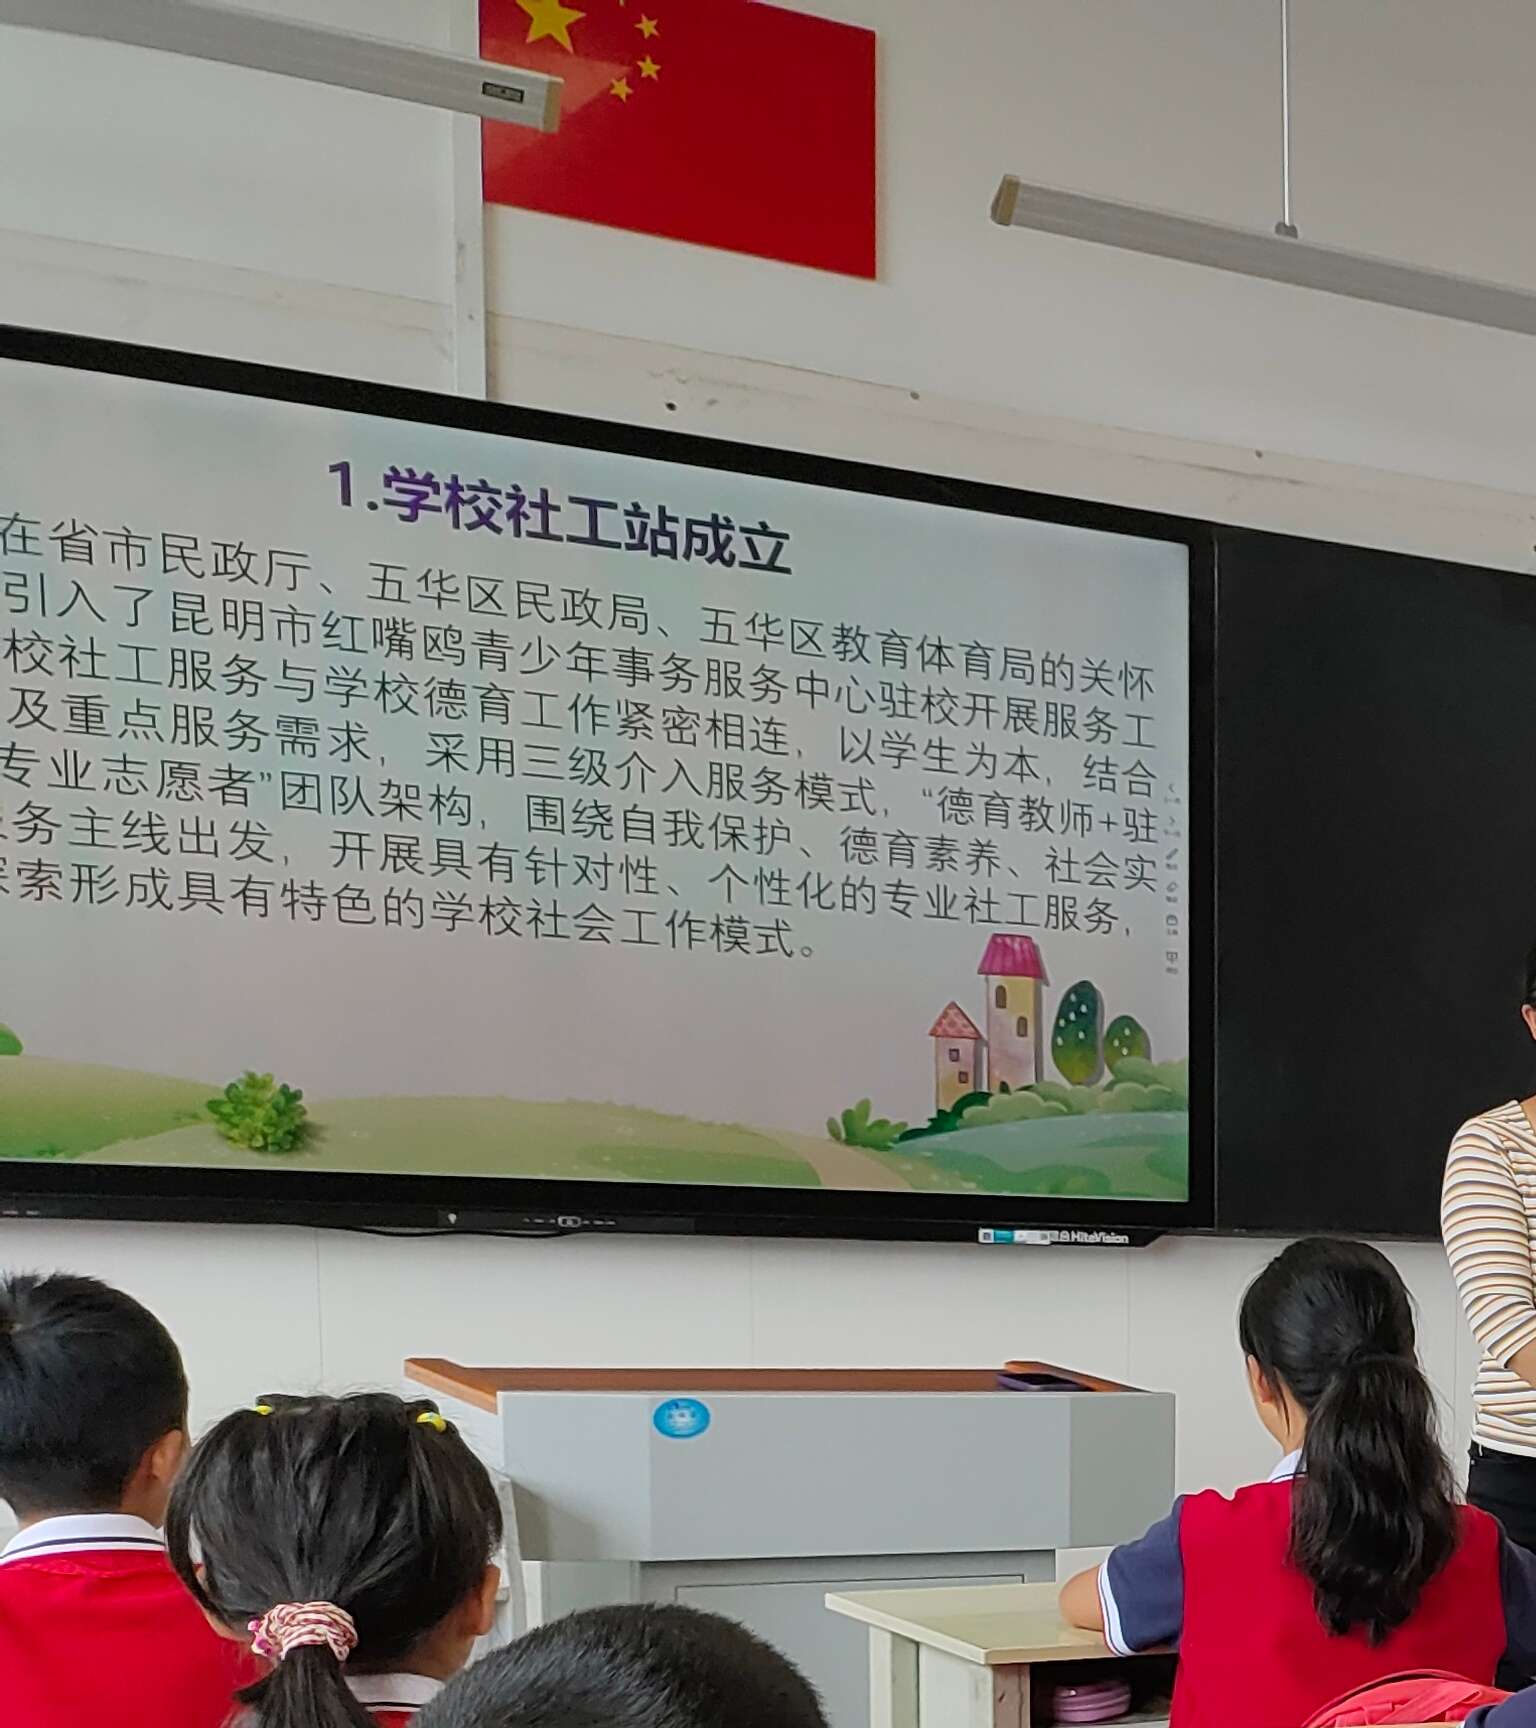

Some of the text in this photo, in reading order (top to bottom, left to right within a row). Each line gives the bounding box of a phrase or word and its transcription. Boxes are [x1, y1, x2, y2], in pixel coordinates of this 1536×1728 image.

[327, 460, 793, 575] 1.学校社工站成立
[0, 511, 1155, 701] 在省市民政厅、五华区民政局、五华区教育体育局的关怀
[2, 571, 1158, 750] 引入了昆明市红嘴鸥青少年事务服务中心驻校开展服务工
[0, 799, 1135, 938] 务主线出发，开展具有针对性、个性化的专业社工服务，
[0, 856, 813, 959] 索形成具有特色的学校社会工作模式。
